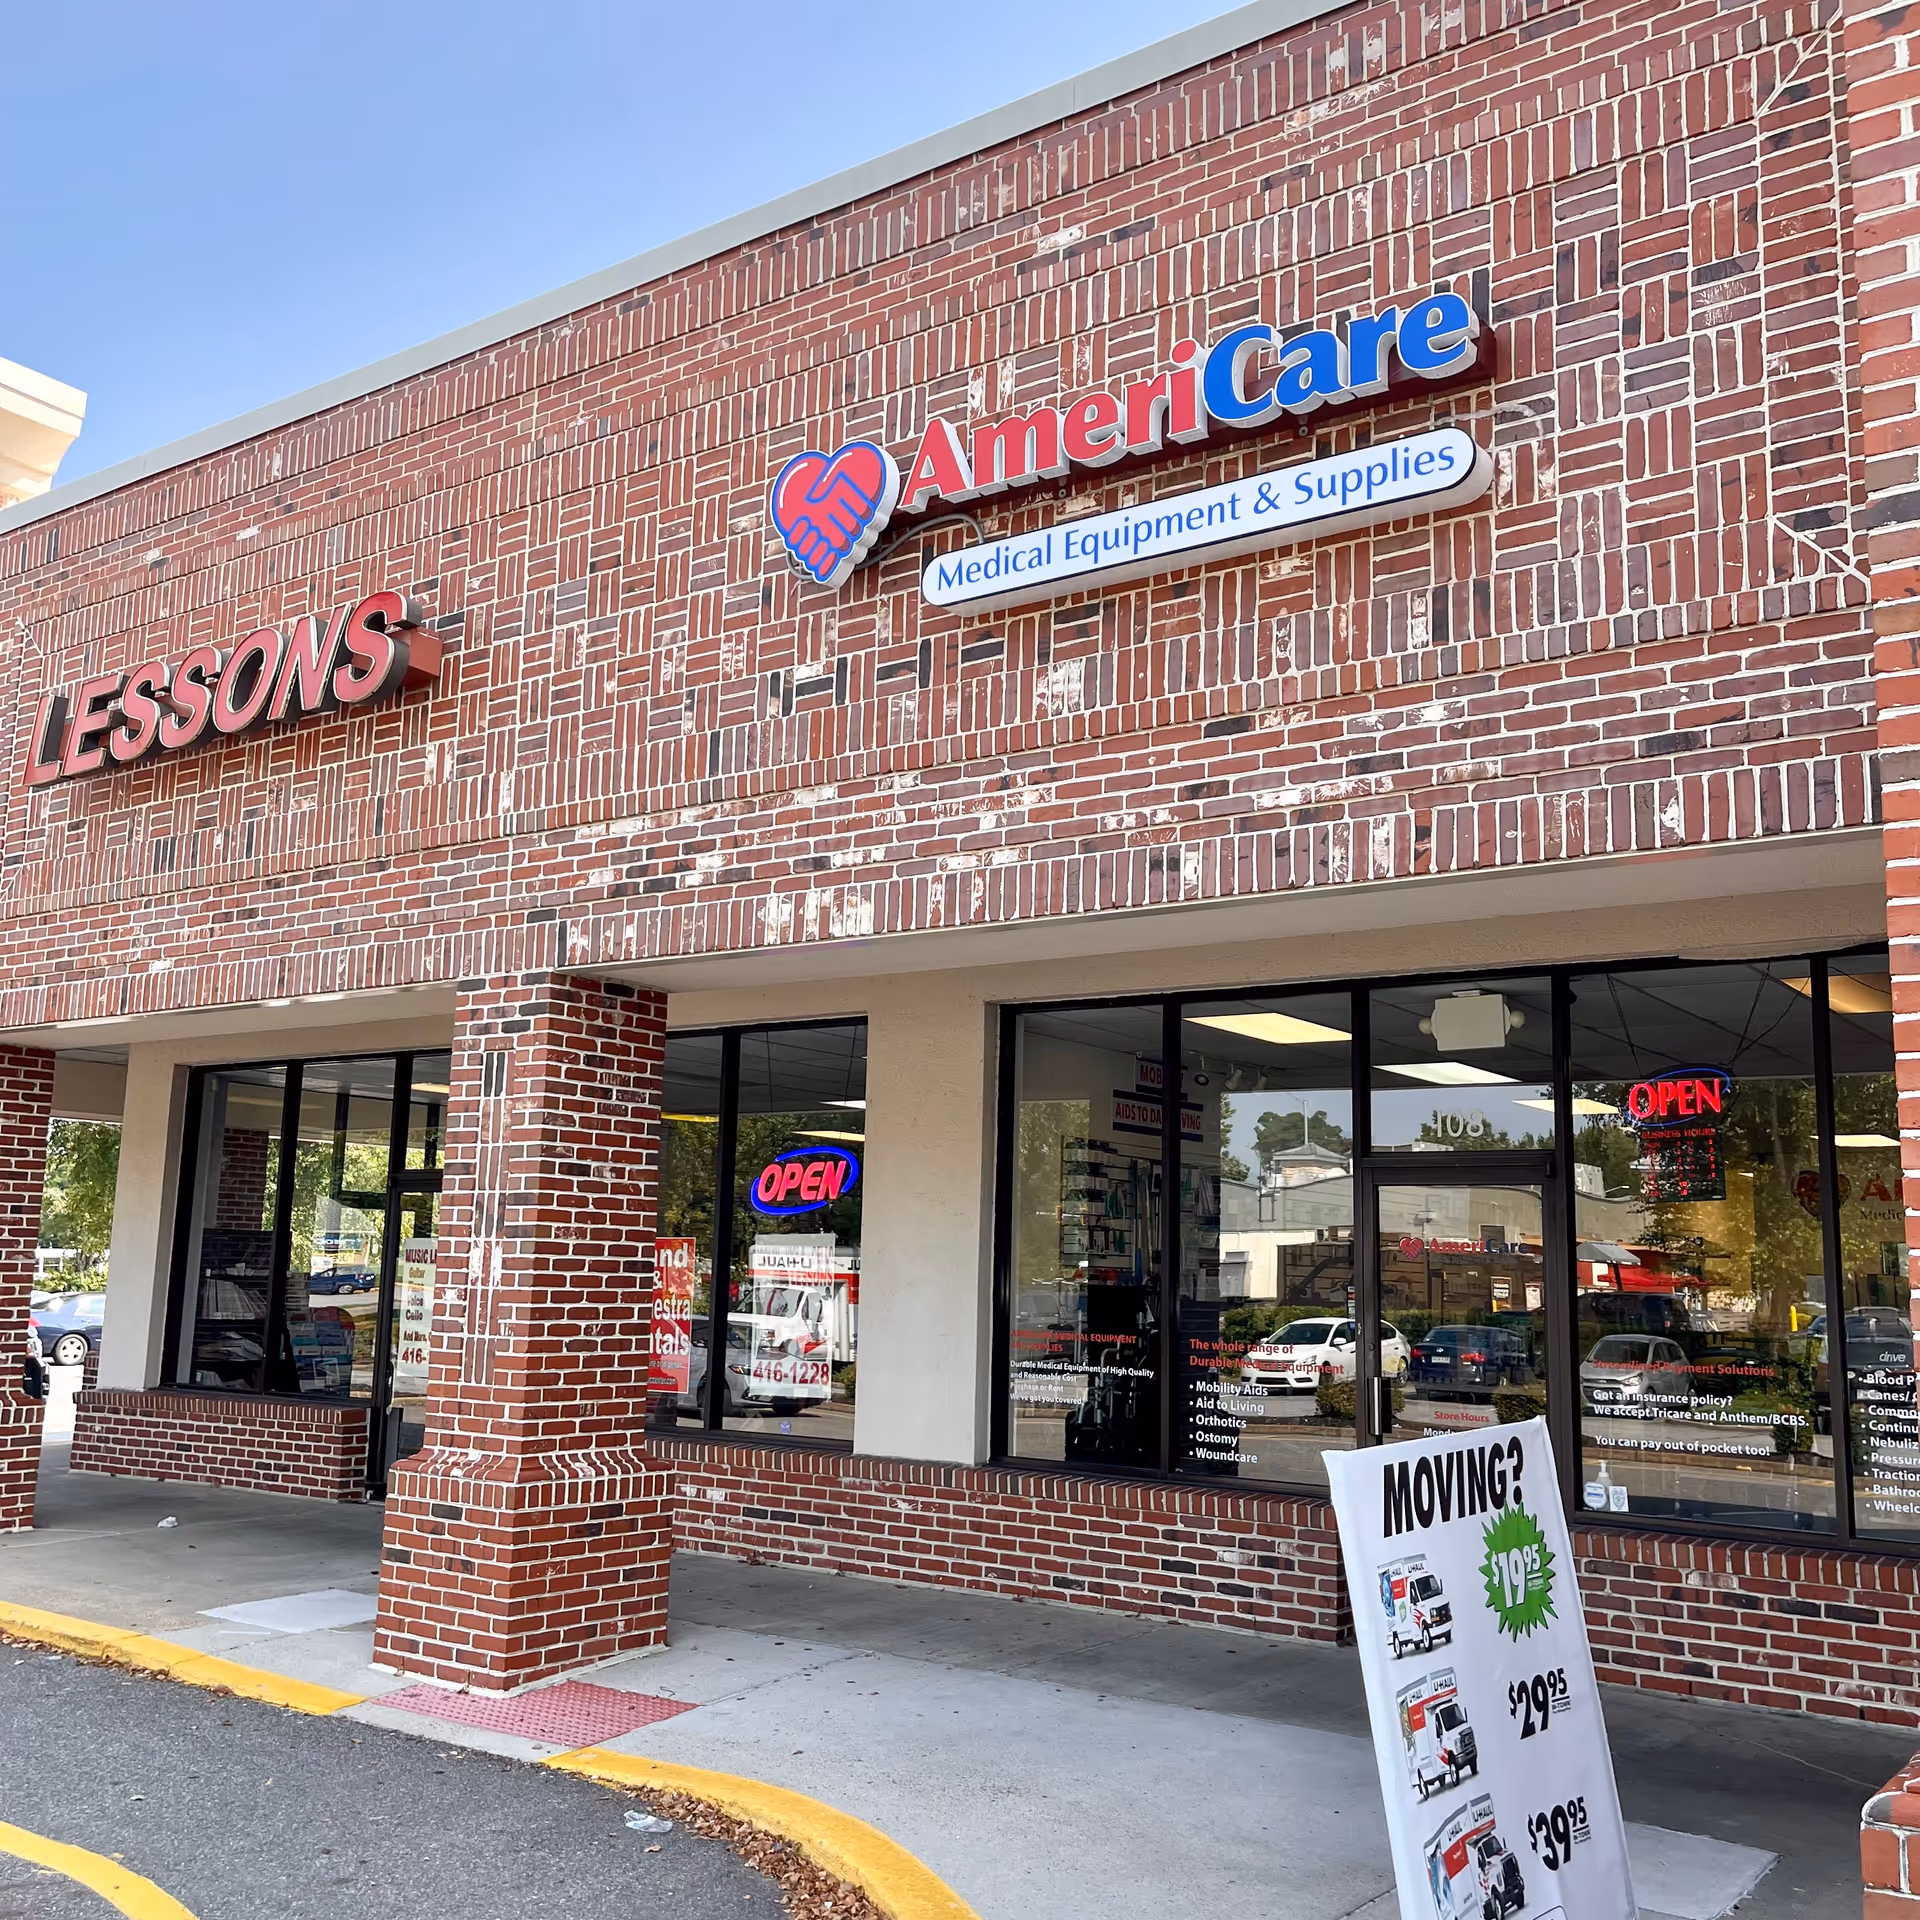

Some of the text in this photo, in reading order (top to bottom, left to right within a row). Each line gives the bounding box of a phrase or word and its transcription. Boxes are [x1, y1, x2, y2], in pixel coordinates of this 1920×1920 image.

[898, 292, 1474, 512] AmeriCare
[938, 445, 1455, 591] Medical Equipment & Supplies
[23, 590, 416, 787] LESSONS
[1629, 1078, 1721, 1119] OPEN
[1115, 1102, 1136, 1121] AIDS
[1138, 1104, 1149, 1122] TO
[1436, 1109, 1485, 1138] 108
[1641, 1128, 1716, 1139] BUSINESS HOURS
[757, 1161, 847, 1202] OPEN
[1427, 1237, 1530, 1255] AmeriCare
[405, 1249, 428, 1263] MUSIC
[405, 1309, 424, 1321] Cello
[652, 1294, 690, 1321] estra
[1090, 1333, 1137, 1344] EQUIPMENT
[1189, 1338, 1294, 1355] The whole range of
[1879, 1351, 1907, 1363] drive
[753, 1361, 830, 1386] 416-1228
[1010, 1360, 1154, 1379] Durable Medical Equipment of High Quality
[1189, 1356, 1344, 1375] Durable Medical Equipment
[1663, 1361, 1715, 1375] Payment
[1717, 1363, 1775, 1377] Solutions
[1024, 1372, 1061, 1381] Reasonable
[1062, 1373, 1077, 1382] Cost
[1866, 1373, 1904, 1386] Blood
[1010, 1383, 1039, 1392] Purchase
[1049, 1384, 1063, 1392] Rent
[1195, 1381, 1268, 1396] Mobility Aids
[1867, 1389, 1910, 1402] Canes/
[1030, 1395, 1041, 1403] got
[1042, 1396, 1055, 1404] you
[1195, 1397, 1265, 1415] Aid to Living
[1593, 1390, 1733, 1408] Got an insurance policy?
[1195, 1414, 1247, 1428] Orthotics
[1433, 1411, 1490, 1423] Store Hours
[1594, 1405, 1810, 1427] We accept Tricare and Anthem/BCBS.
[1423, 1428, 1457, 1437] Mond
[1868, 1420, 1918, 1434] Continu
[1195, 1431, 1238, 1447] Ostomy
[1595, 1435, 1771, 1457] You can pay out of pocket too!
[1870, 1436, 1919, 1450] Nebuliz
[1195, 1447, 1258, 1463] Woundcare
[1383, 1435, 1524, 1539] MOVING?
[1873, 1499, 1920, 1514] Wheelc
